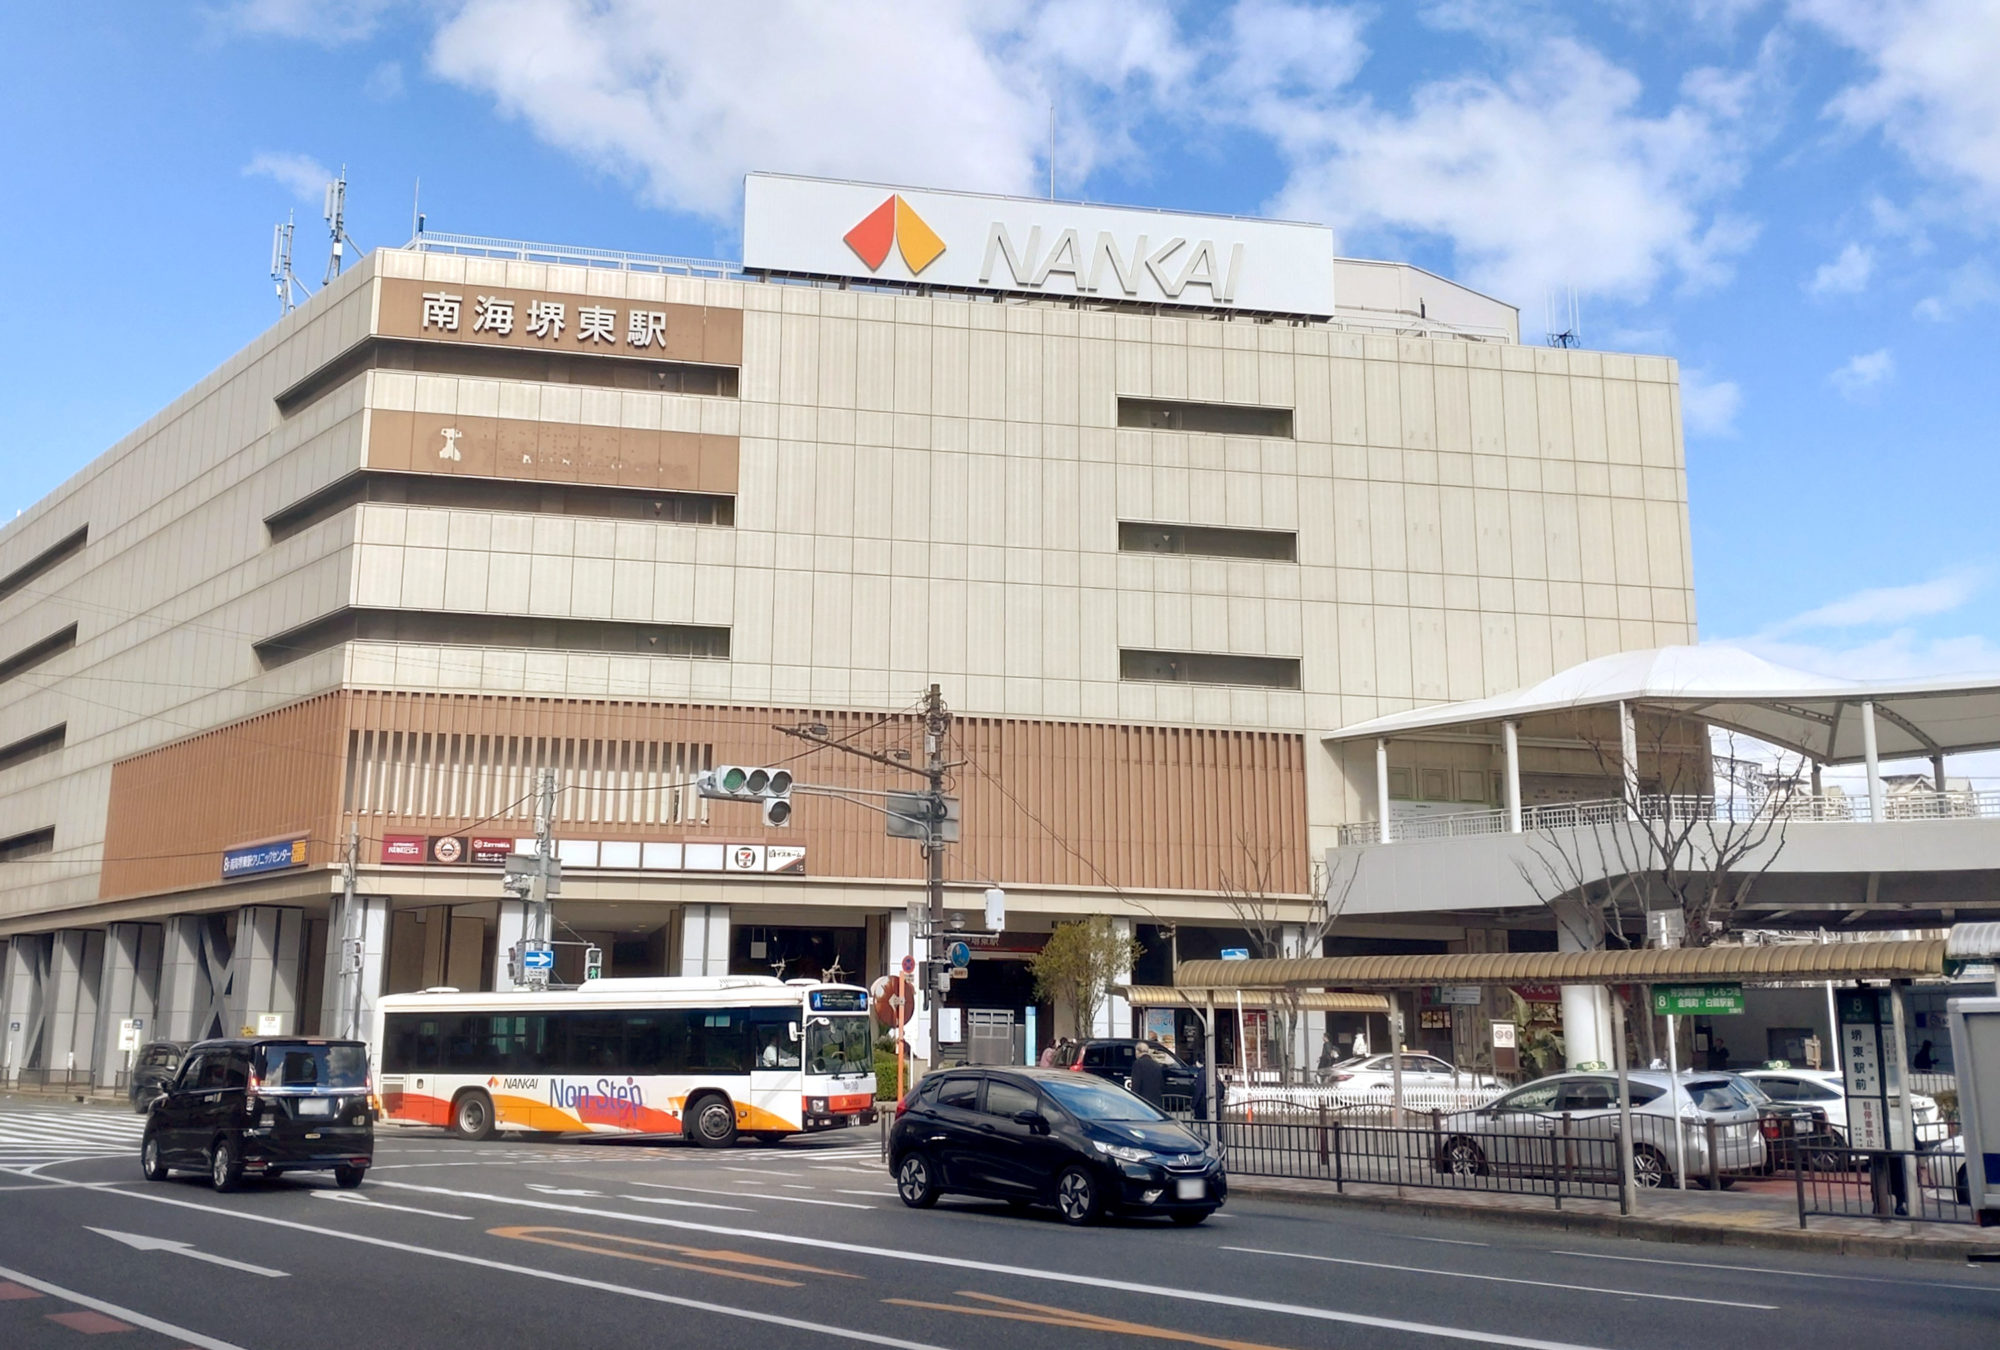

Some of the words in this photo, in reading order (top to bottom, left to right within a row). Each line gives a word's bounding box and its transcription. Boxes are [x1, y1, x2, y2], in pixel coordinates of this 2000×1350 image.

[979, 221, 1245, 303] NANKAI
[421, 290, 668, 349] 南海堺東駅
[1658, 995, 1667, 1008] 8
[1852, 997, 1863, 1012] 8
[1850, 1028, 1867, 1091] 堺東駅前
[503, 1078, 539, 1090] NANKAI
